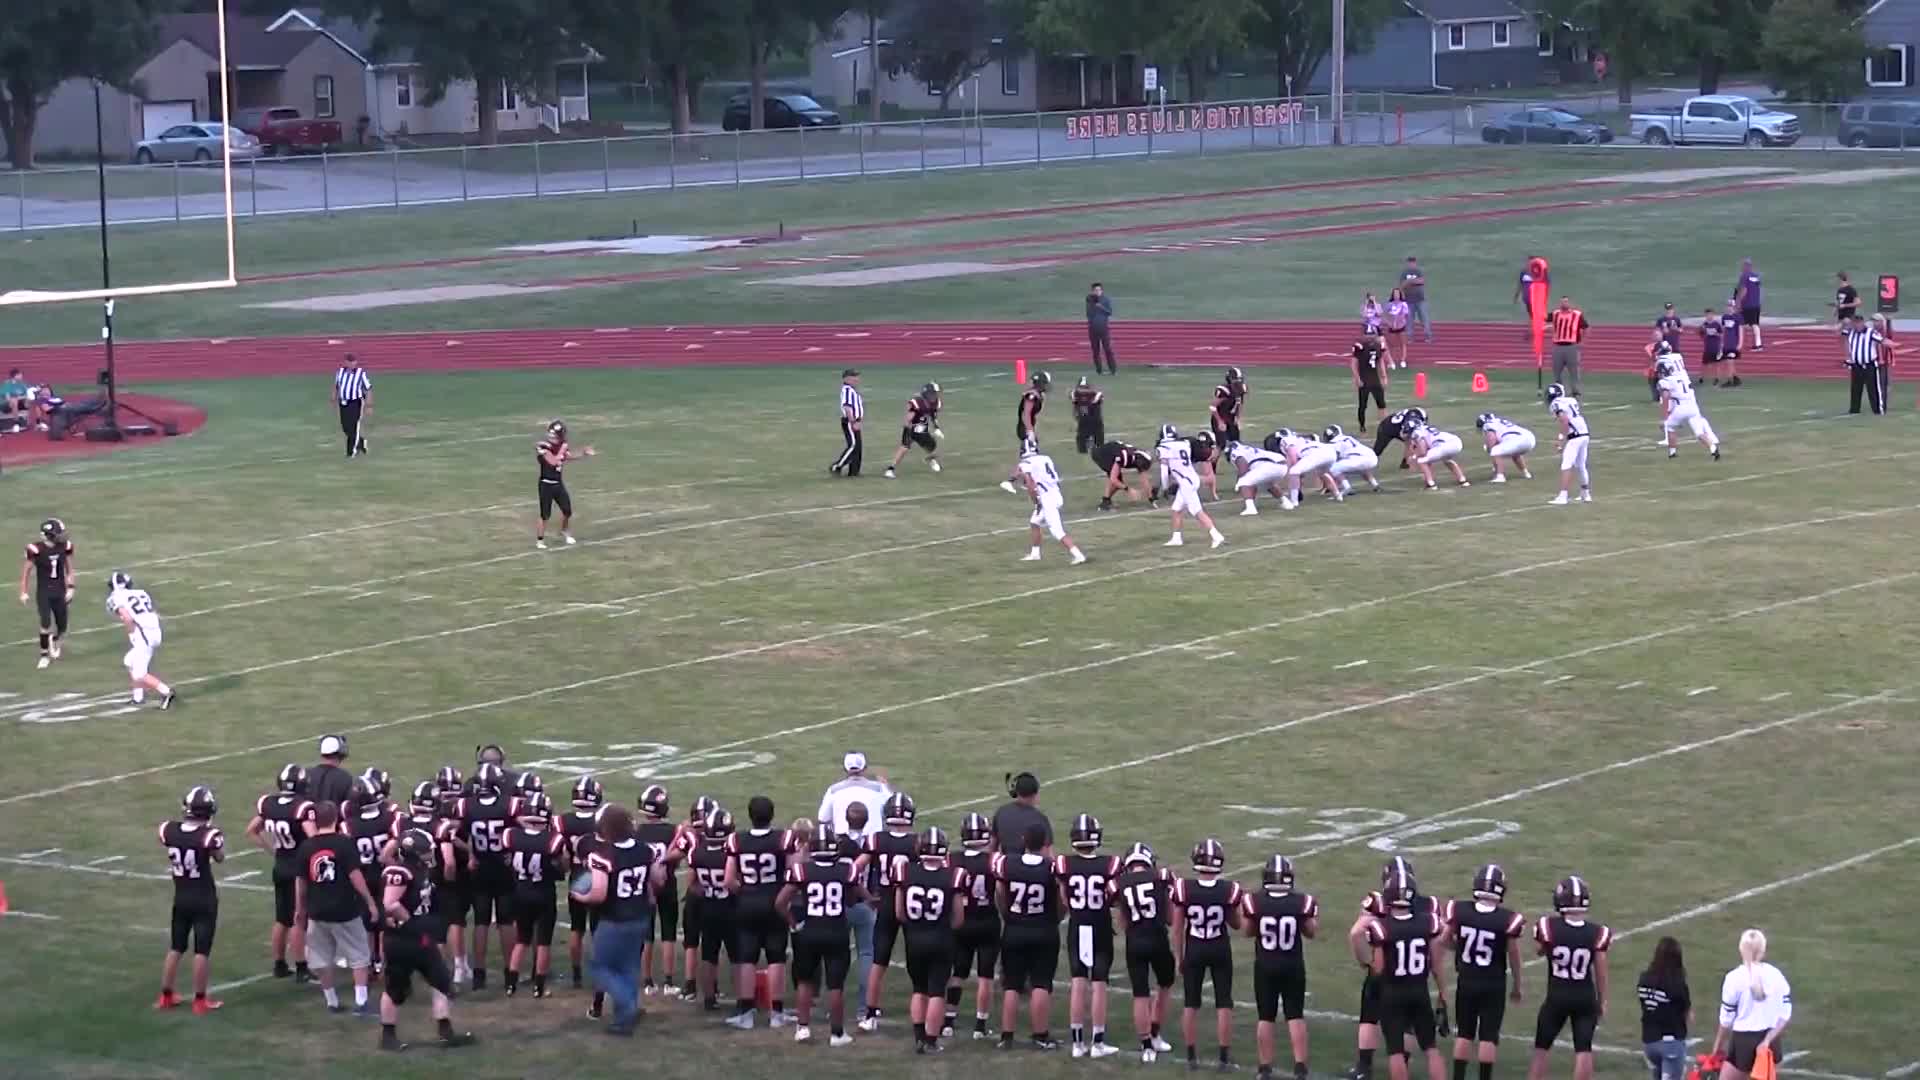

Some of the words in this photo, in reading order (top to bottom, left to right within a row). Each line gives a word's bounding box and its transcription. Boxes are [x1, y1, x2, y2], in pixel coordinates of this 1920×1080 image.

[1881, 277, 1897, 299] 3
[1179, 449, 1190, 467] 9
[471, 819, 505, 852] 65
[512, 851, 543, 882] 44
[617, 864, 647, 899] 67
[740, 852, 777, 885] 52
[807, 881, 843, 917] 28
[906, 885, 945, 920] 63
[1009, 881, 1046, 914] 72
[1069, 874, 1105, 910] 36
[1123, 882, 1157, 922] 15
[1187, 904, 1224, 939] 22
[1394, 937, 1426, 977] 16
[1460, 925, 1496, 967] 75
[1552, 945, 1592, 980] 20
